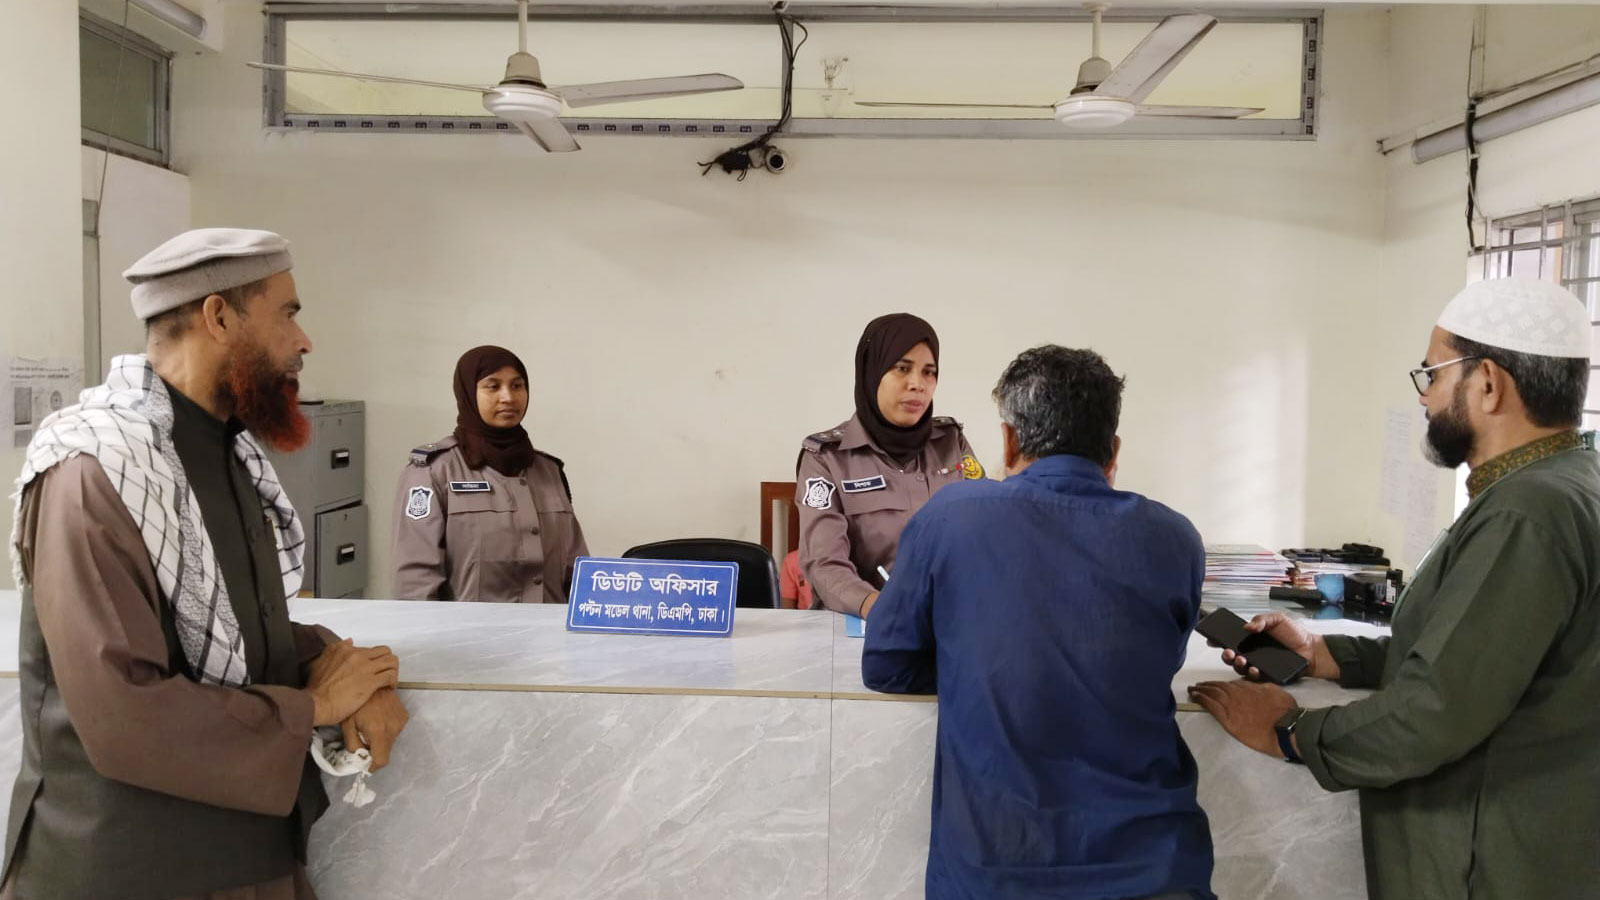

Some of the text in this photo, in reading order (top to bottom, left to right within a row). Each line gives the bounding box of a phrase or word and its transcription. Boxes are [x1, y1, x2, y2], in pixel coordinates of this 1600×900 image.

[591, 570, 719, 596] ডিউটি অফিসার
[604, 604, 630, 619] মডেল
[632, 604, 654, 624] থানা,
[657, 601, 695, 625] ডিএমপি,
